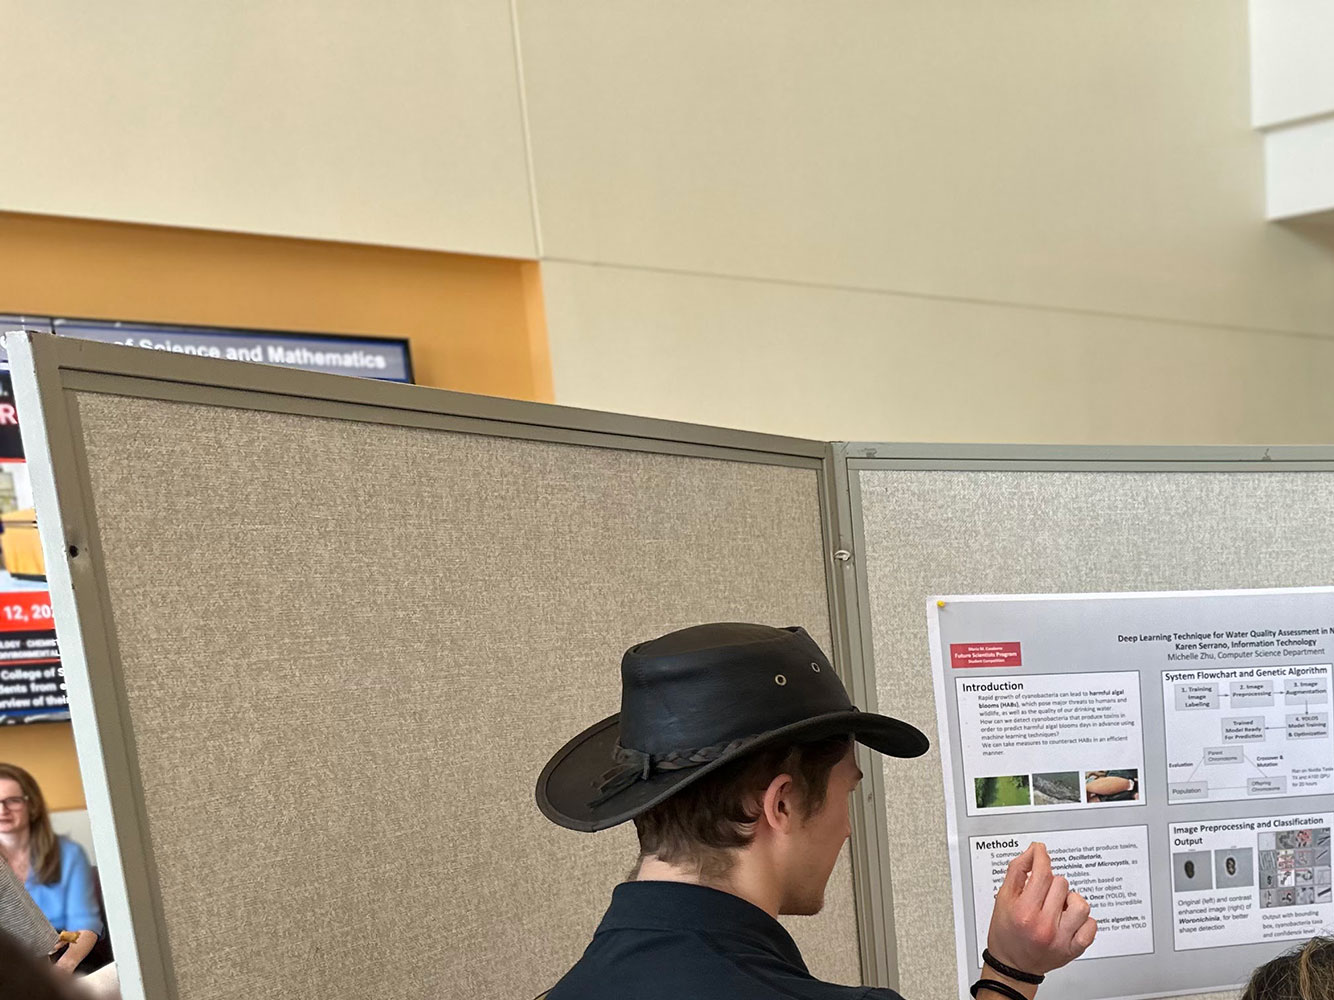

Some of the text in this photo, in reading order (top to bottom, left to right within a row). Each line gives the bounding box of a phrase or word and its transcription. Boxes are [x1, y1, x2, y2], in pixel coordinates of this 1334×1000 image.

[226, 346, 263, 362] and
[267, 345, 387, 369] Mathematics
[1118, 635, 1138, 644] Deep
[1139, 634, 1172, 642] Learning
[1173, 632, 1211, 641] Technique
[1212, 631, 1224, 639] for
[1225, 631, 1248, 639] Water
[1249, 630, 1276, 639] Quality
[1277, 629, 1319, 637] Assessment
[1320, 628, 1328, 636] in
[1198, 642, 1229, 650] Serrano,
[1230, 640, 1274, 649] Information
[1275, 638, 1317, 648] Technology
[1168, 652, 1198, 660] Michelle
[1199, 652, 1215, 660] Zhu,
[1216, 651, 1253, 660] Computer
[1282, 649, 1325, 658] Department
[1165, 666, 1327, 682] System Flowchart and Genetic Algorithm
[963, 681, 1023, 692] Introduction
[978, 694, 993, 702] Rapid
[994, 693, 1013, 701] growth
[1021, 692, 1058, 700] cyanobacteria
[1031, 715, 1068, 723] cyanobacteria
[1003, 725, 1022, 733] predict
[1045, 723, 1058, 731] algal
[1172, 787, 1201, 795] Population
[1174, 817, 1323, 835] Image Preprocessing and Classification
[976, 838, 1019, 849] Methods
[1174, 837, 1203, 847] Output
[1095, 844, 1118, 852] produce
